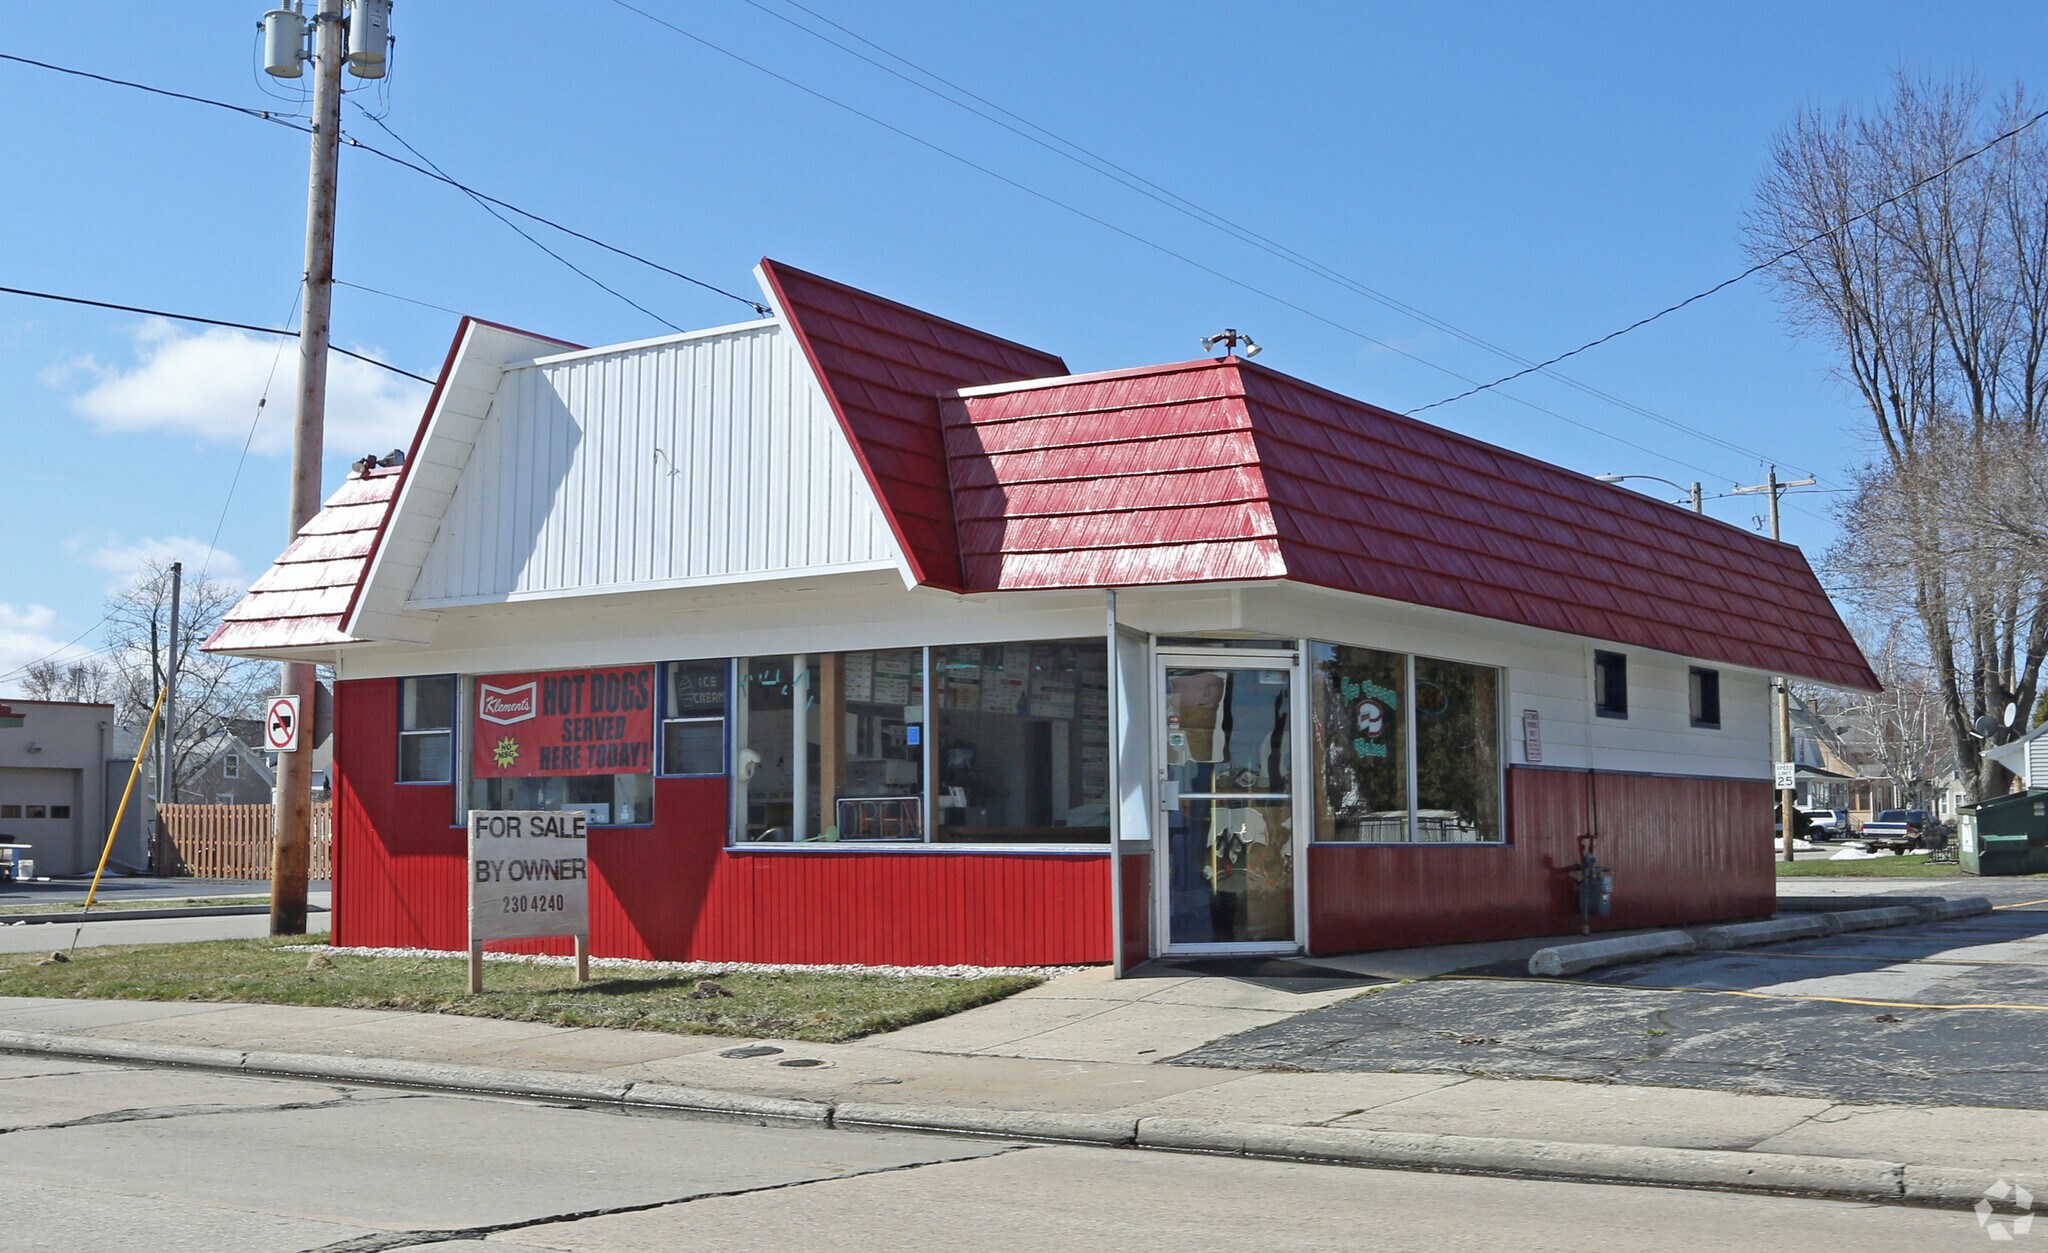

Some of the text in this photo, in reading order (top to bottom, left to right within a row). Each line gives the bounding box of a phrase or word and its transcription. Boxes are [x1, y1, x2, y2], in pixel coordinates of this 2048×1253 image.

[543, 669, 649, 715] HOT DOGS
[698, 676, 717, 687] ICE
[1341, 676, 1360, 707] Ice
[485, 696, 531, 714] Klement's
[561, 716, 626, 742] SERVED
[498, 750, 514, 759] MSG
[501, 743, 512, 751] NO
[540, 742, 649, 770] HERE TODAY!
[1778, 776, 1793, 786] 25
[475, 816, 586, 839] FOR SALE
[840, 801, 920, 838] OPEN
[475, 858, 587, 883] BY OWNER
